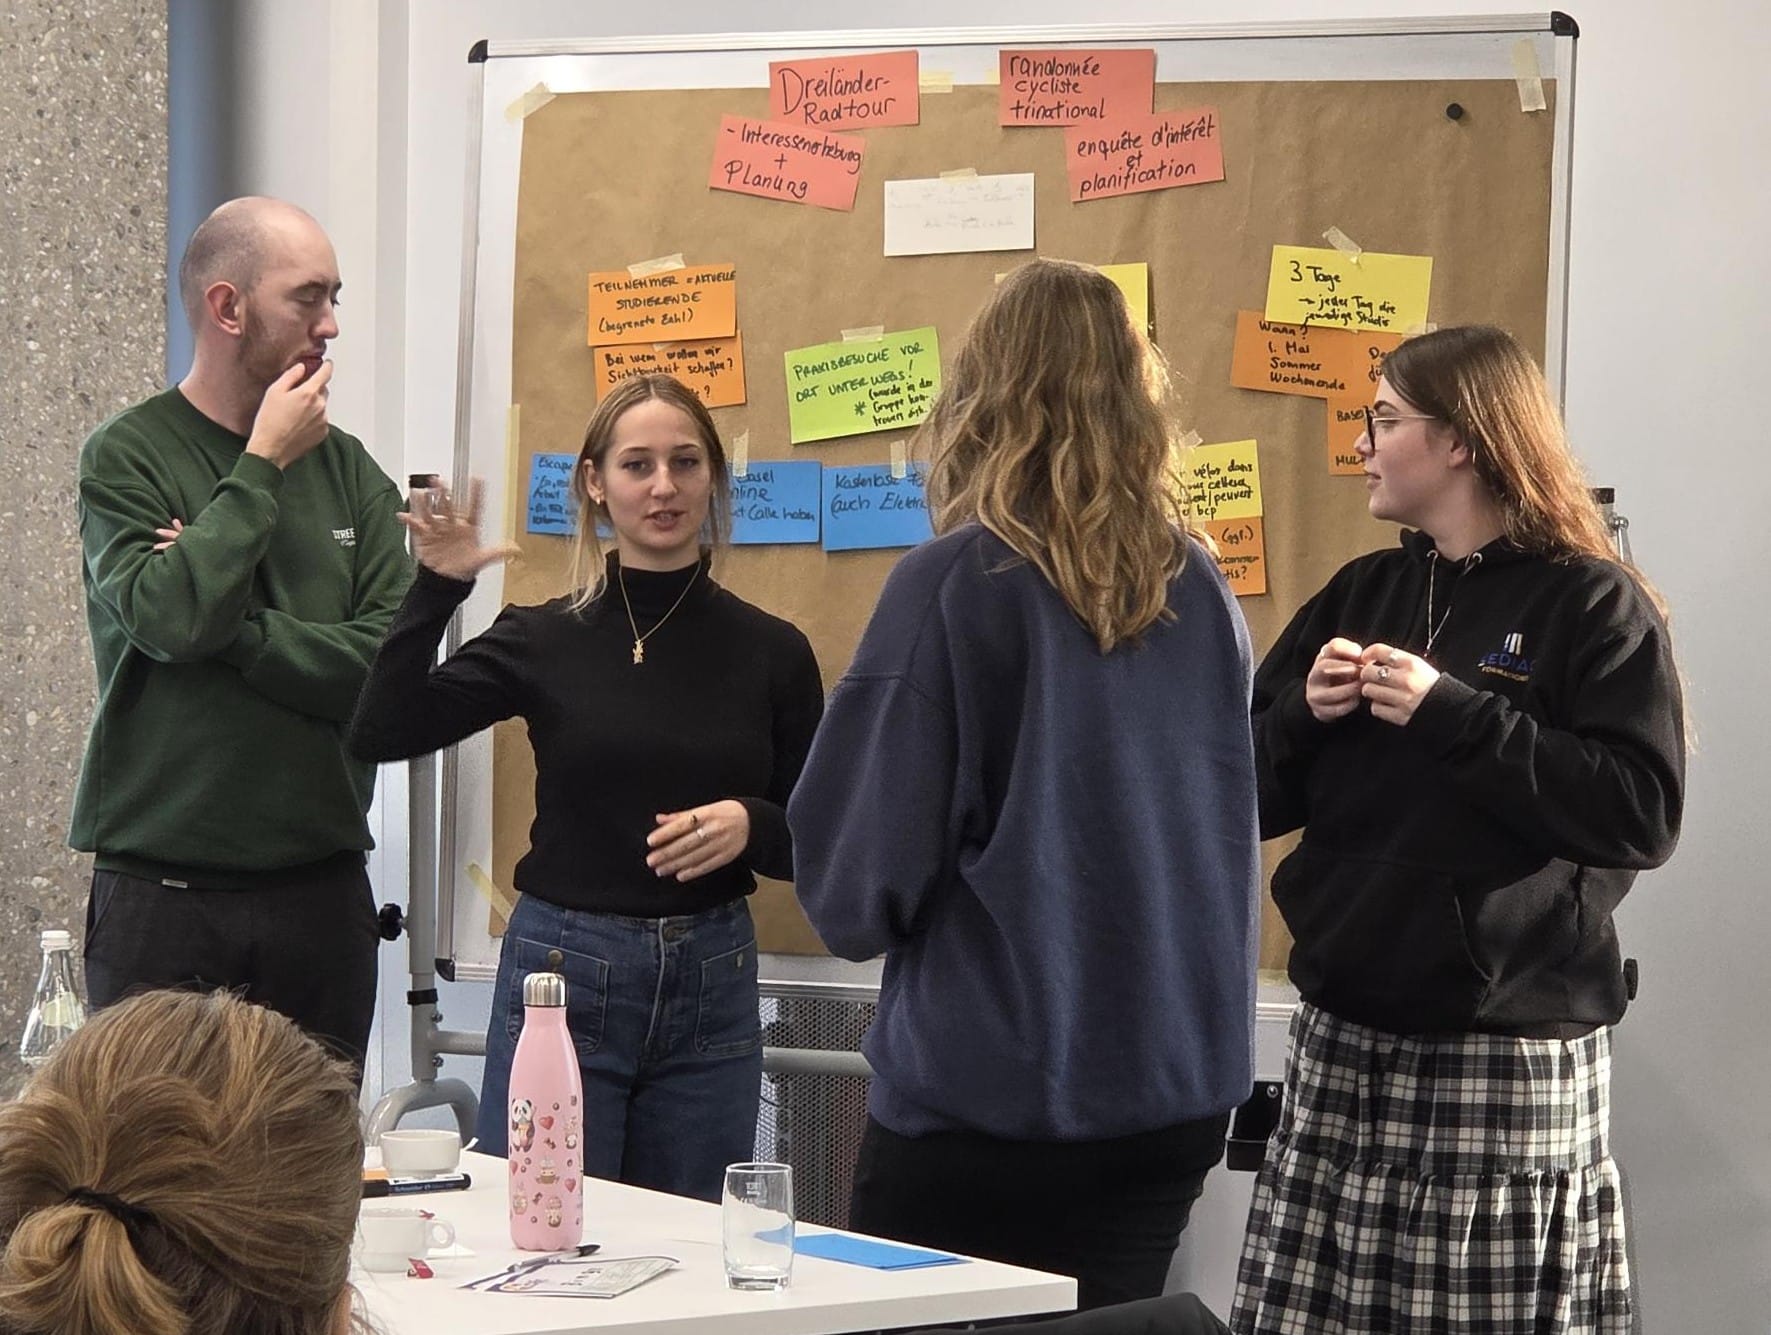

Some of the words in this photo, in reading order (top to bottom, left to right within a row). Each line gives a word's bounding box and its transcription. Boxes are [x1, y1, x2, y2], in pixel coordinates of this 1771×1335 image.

[1010, 56, 1100, 77] randonnée
[778, 67, 890, 115] Dreiländer-
[1015, 79, 1082, 101] cycliste
[803, 98, 896, 124] Radtour
[1010, 98, 1107, 119] trinational
[1077, 131, 1142, 160] enquête
[1152, 114, 1216, 148] d'intérêt
[1126, 150, 1142, 167] et
[1079, 160, 1196, 198] planification
[594, 276, 679, 293] TEILNEHMER
[1290, 260, 1303, 281] 3
[1306, 266, 1341, 292] Tage
[616, 291, 702, 310] STUDIERENDE
[1286, 341, 1310, 354] Mai
[605, 353, 624, 367] Bei
[793, 348, 889, 381] PRAXISBESUCHE
[900, 342, 924, 356] VOR
[1270, 357, 1321, 371] Sommer
[796, 385, 818, 402] ORT
[1228, 459, 1253, 472] dans
[730, 486, 773, 502] nline
